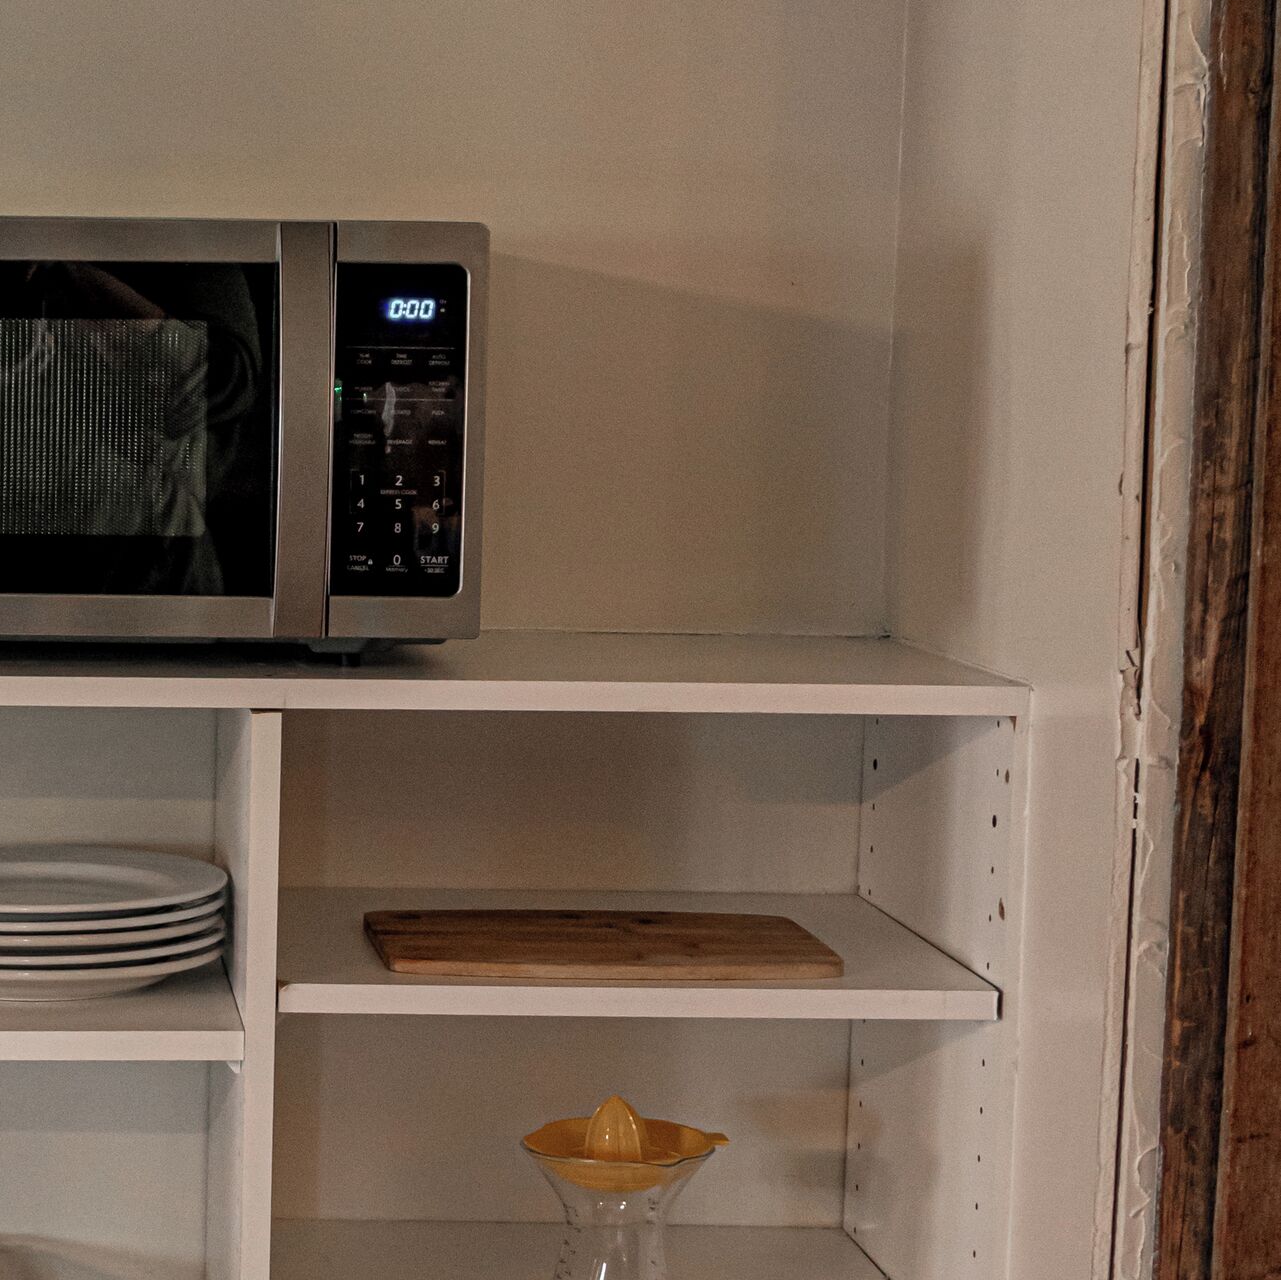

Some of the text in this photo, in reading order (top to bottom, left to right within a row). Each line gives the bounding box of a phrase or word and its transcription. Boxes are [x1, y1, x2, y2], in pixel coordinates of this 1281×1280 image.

[389, 299, 435, 319] 0:00
[359, 475, 440, 487] 1 2 3
[356, 498, 440, 510] 4 5 6
[356, 521, 440, 534] 7 8 9
[349, 554, 367, 562] STOP
[393, 554, 401, 566] 0
[420, 555, 450, 565] START
